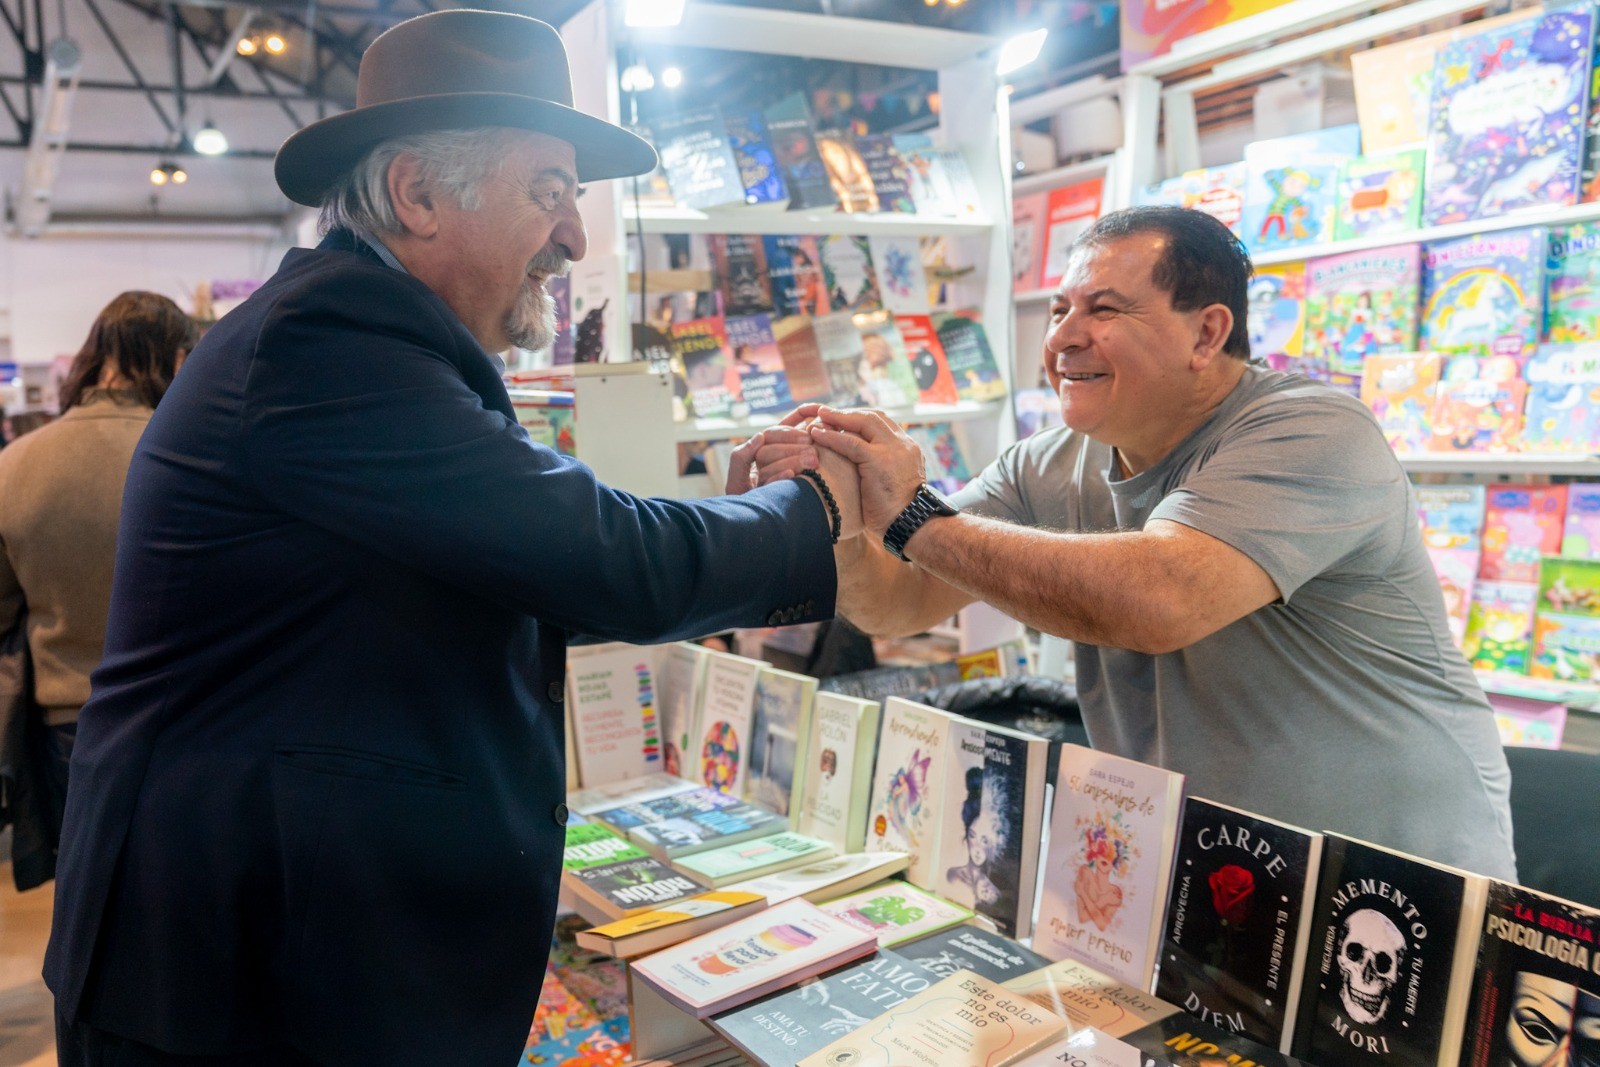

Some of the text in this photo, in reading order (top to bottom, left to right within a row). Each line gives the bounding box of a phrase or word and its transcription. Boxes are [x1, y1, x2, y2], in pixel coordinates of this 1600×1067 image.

[820, 706, 852, 728] GABRIEL
[1089, 768, 1135, 789] SARA ESPEJO
[1138, 796, 1155, 817] de
[1197, 823, 1288, 879] CARPE
[1172, 875, 1192, 945] APROVECHA
[1330, 878, 1428, 940] MEMENTO
[1513, 902, 1594, 944] LA BIBLIA
[735, 947, 759, 960] para
[744, 937, 778, 958] Terapia
[1266, 909, 1289, 991] EL PRESENTE
[1320, 925, 1337, 975] RECUERDA
[1485, 914, 1590, 972] PSICOLOGÍA
[841, 972, 909, 1011] FATI
[864, 958, 930, 993] AMO
[1065, 966, 1157, 1012] Este dolor
[1405, 956, 1424, 1017] TU MUERTE
[955, 1009, 988, 1028] mío
[958, 979, 1042, 1025] Este dolor
[963, 998, 1009, 1024] no es
[1184, 991, 1247, 1033] DIEM
[752, 1014, 798, 1046] DESTINO
[769, 1011, 811, 1037] AMA TU
[1330, 1014, 1391, 1055] MORI
